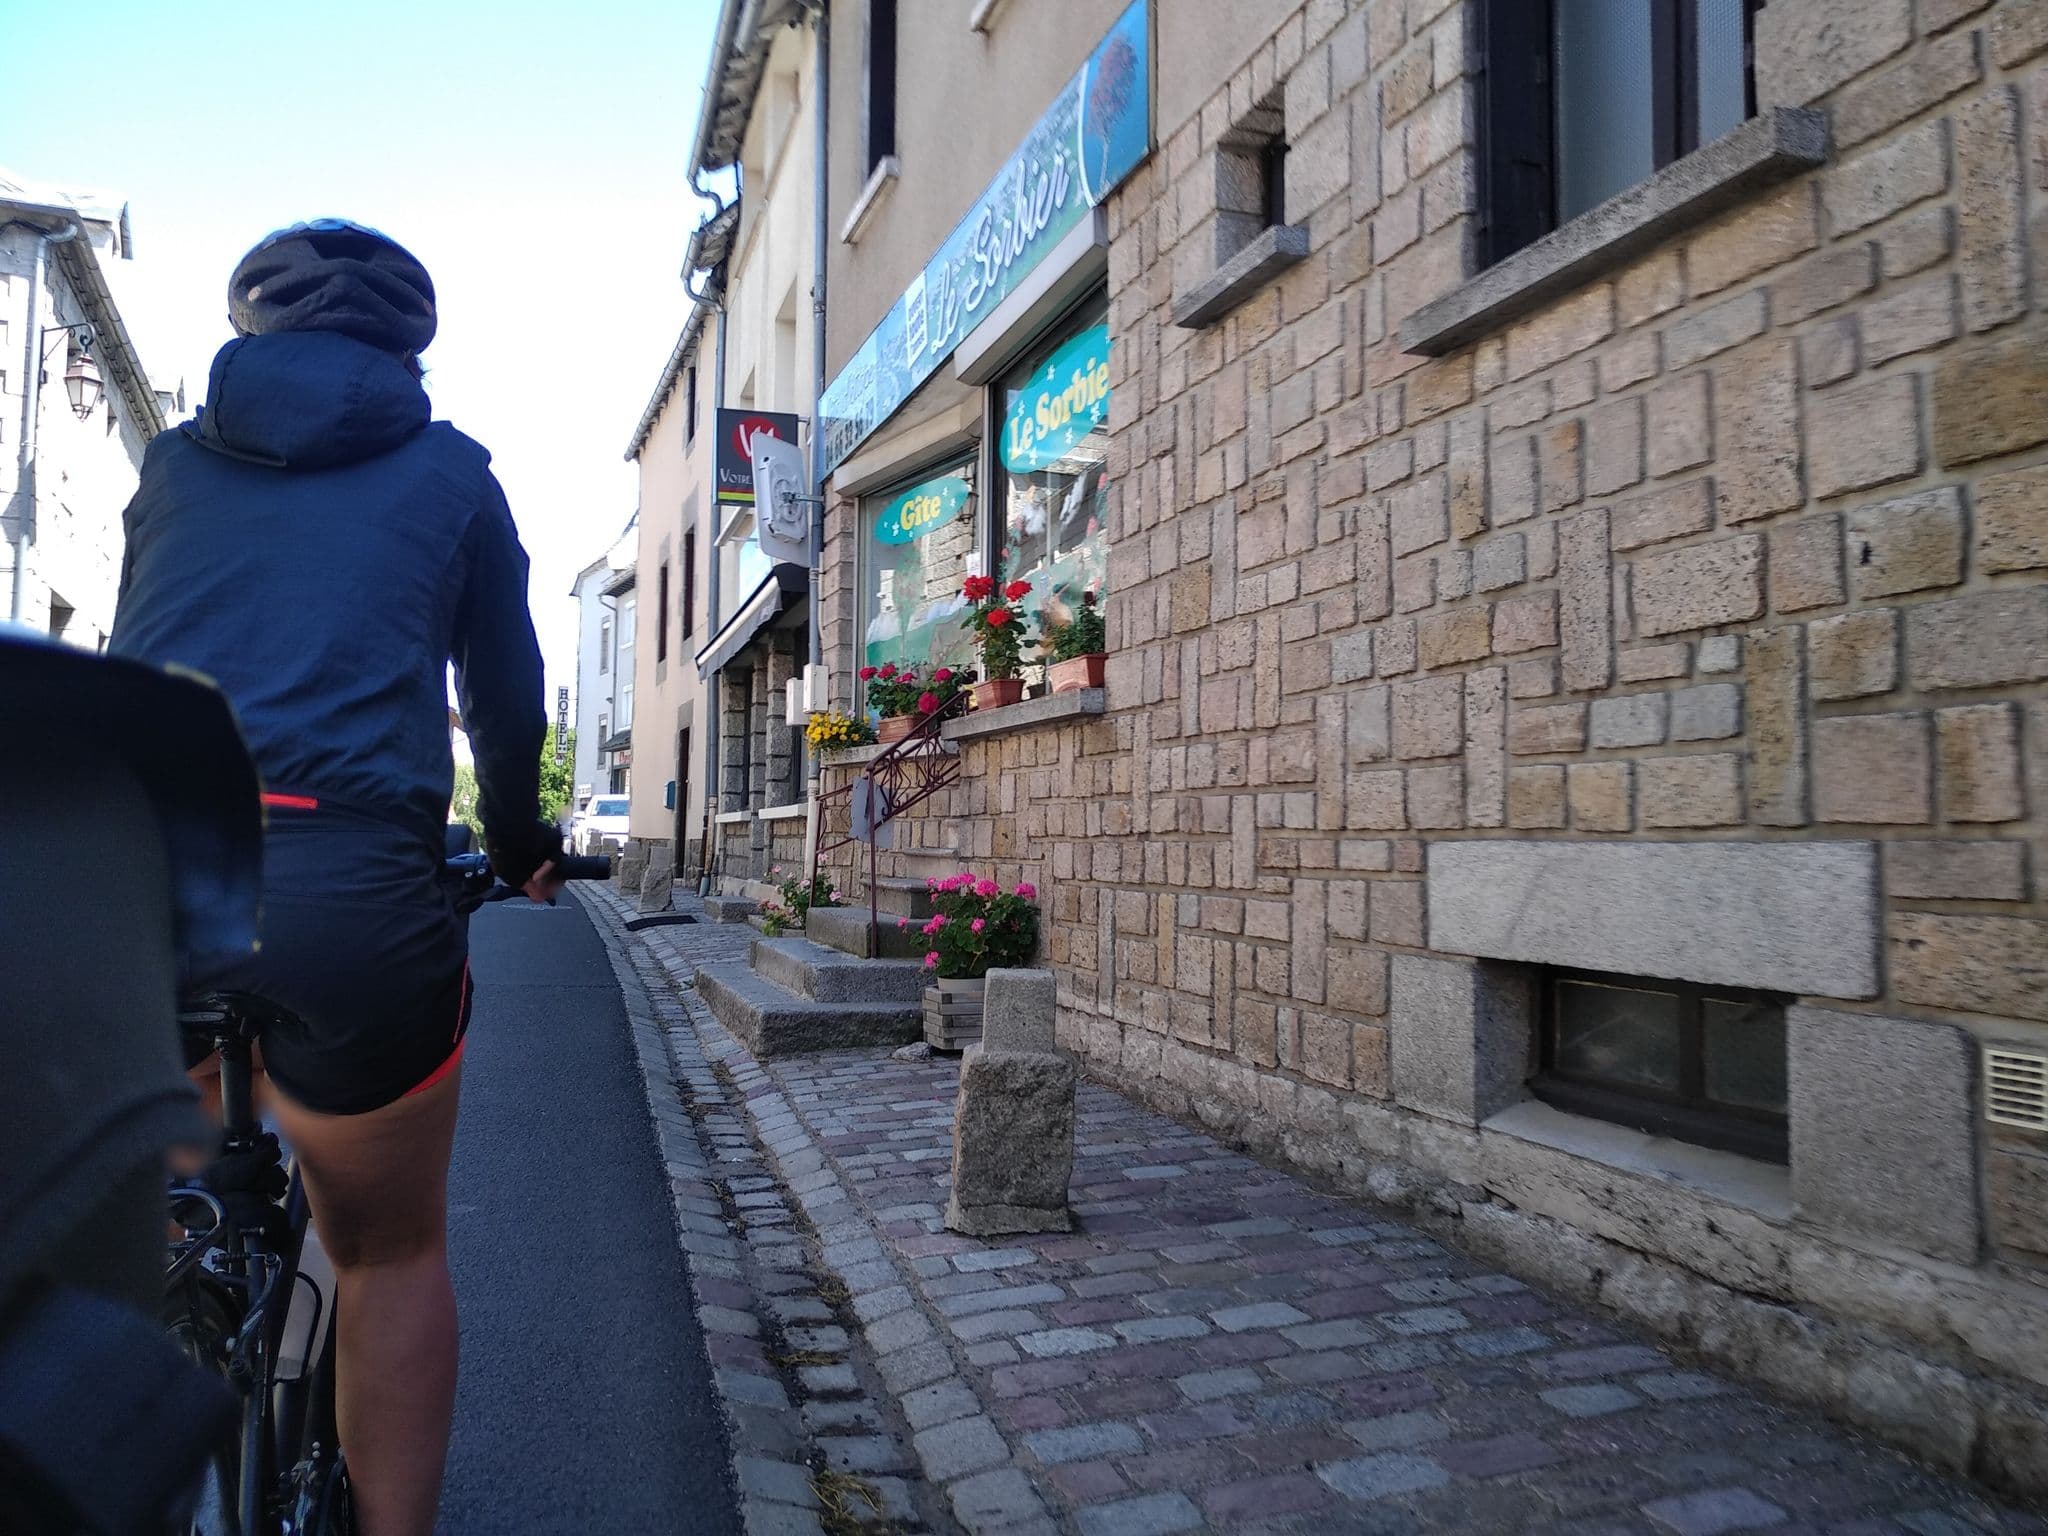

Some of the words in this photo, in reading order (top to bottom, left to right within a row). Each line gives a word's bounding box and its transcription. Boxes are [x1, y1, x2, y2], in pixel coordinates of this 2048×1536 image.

[930, 260, 960, 355] Le
[965, 154, 1070, 313] Sorbier
[1008, 416, 1034, 460] Le
[559, 688, 569, 746] HOTEL
